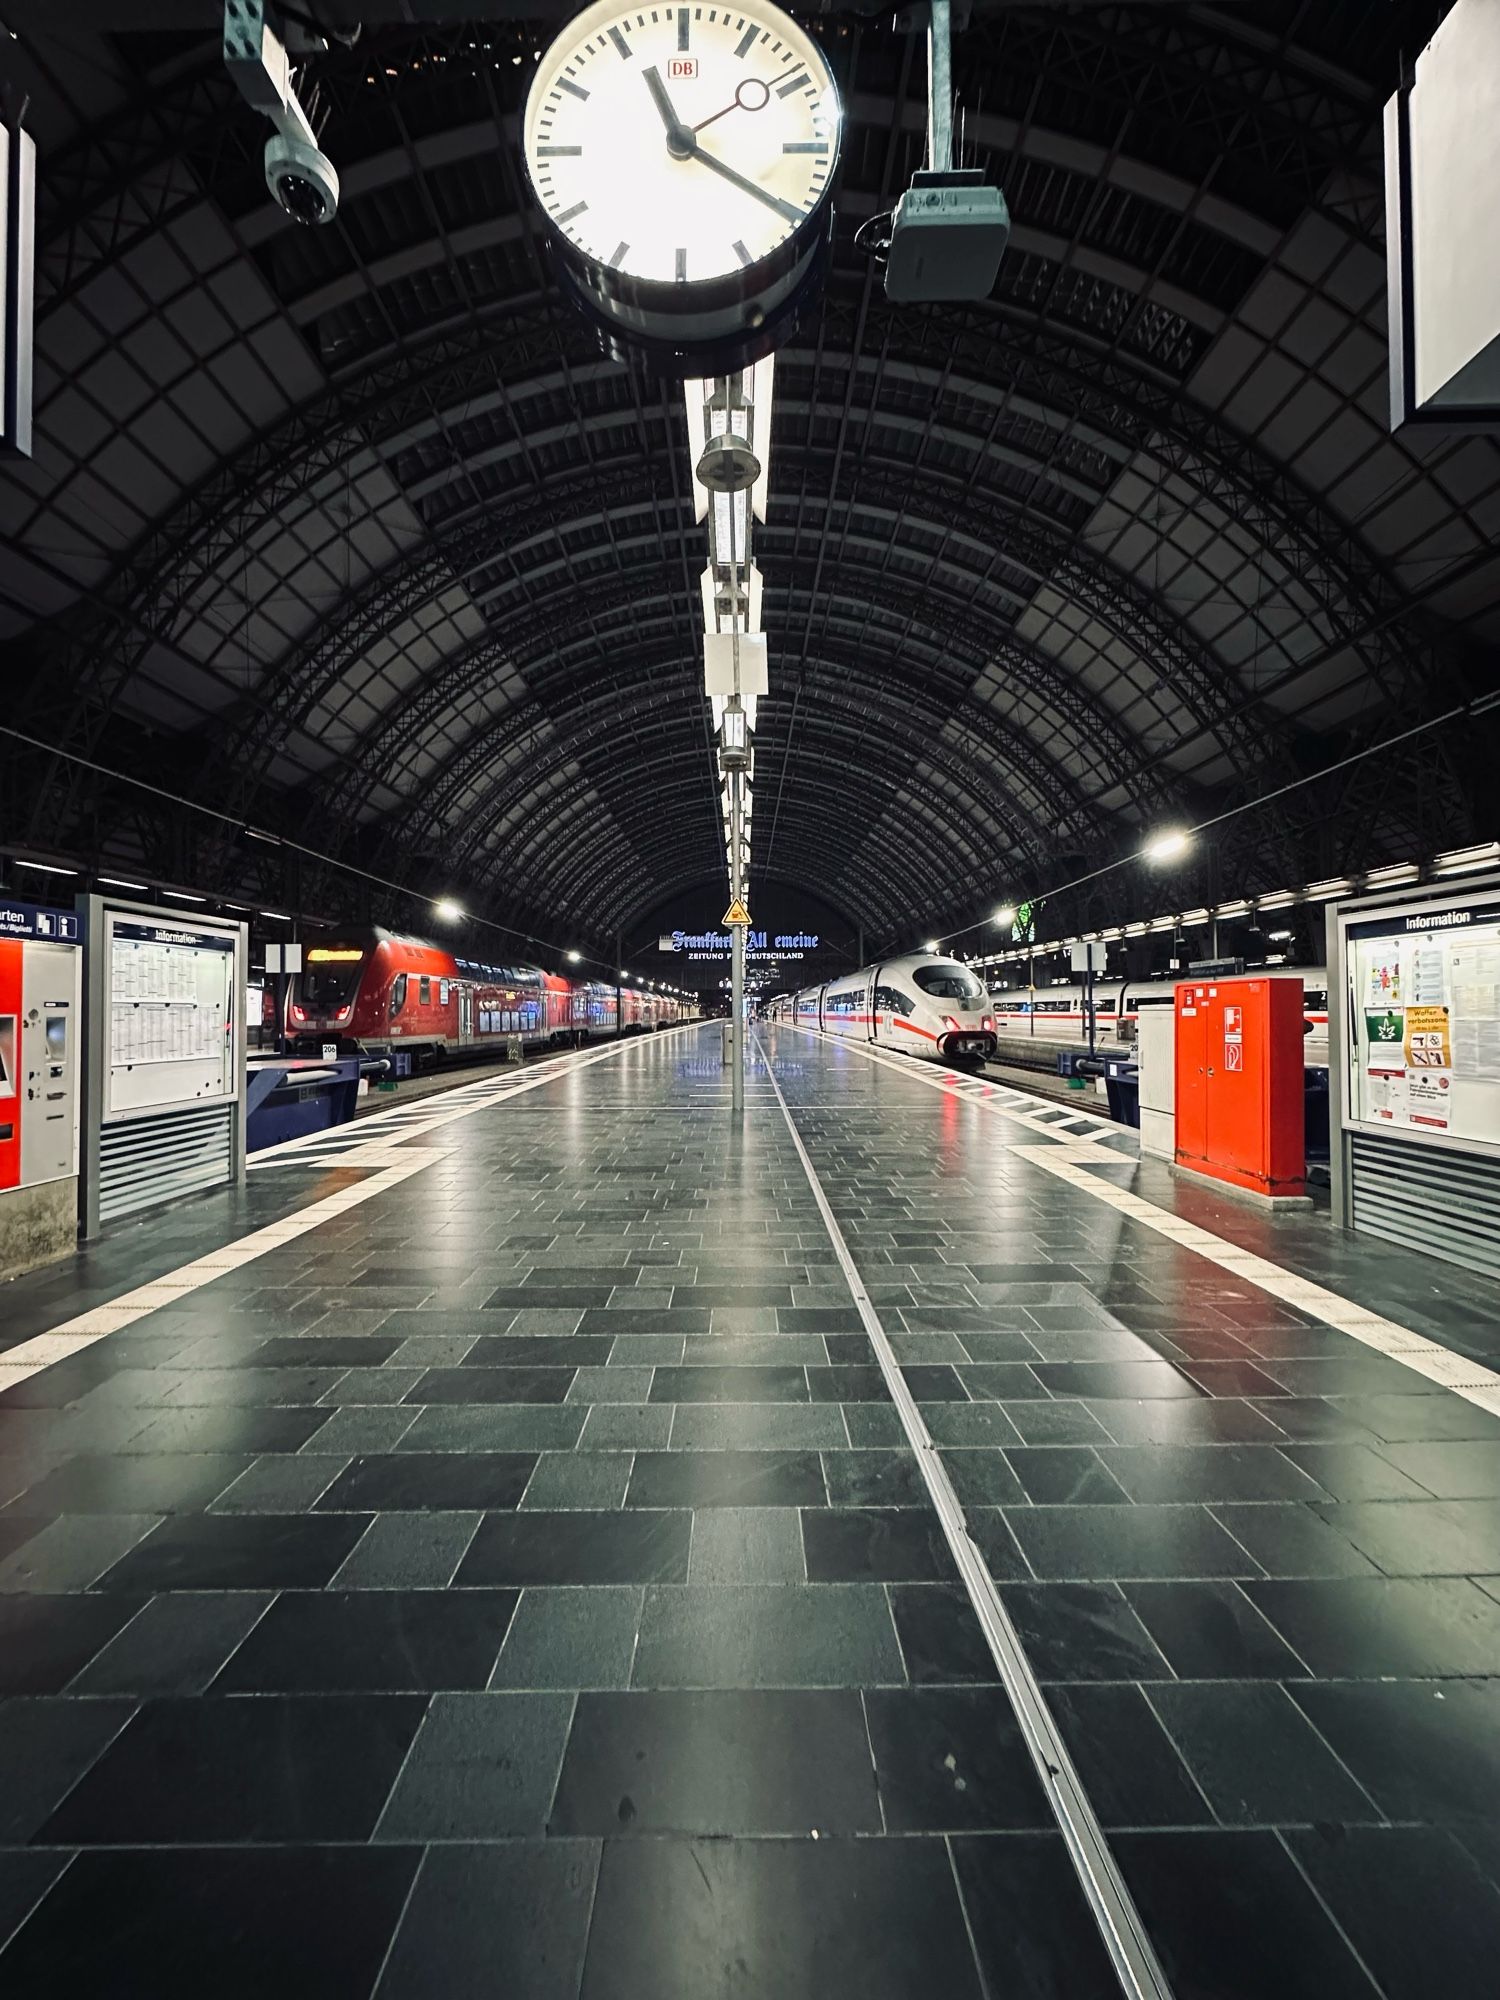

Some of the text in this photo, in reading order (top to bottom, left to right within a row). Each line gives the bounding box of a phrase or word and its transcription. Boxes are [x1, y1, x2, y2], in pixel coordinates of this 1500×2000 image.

[673, 62, 692, 75] DB
[1406, 911, 1470, 930] Information
[155, 929, 196, 945] Information
[672, 930, 733, 952] Frankfurt
[688, 952, 724, 960] ZEITUNG
[745, 952, 804, 960] DEUTSCHLAND
[1320, 991, 1327, 1000] 2
[323, 1045, 336, 1053] 206
[1130, 1044, 1139, 1052] 20
